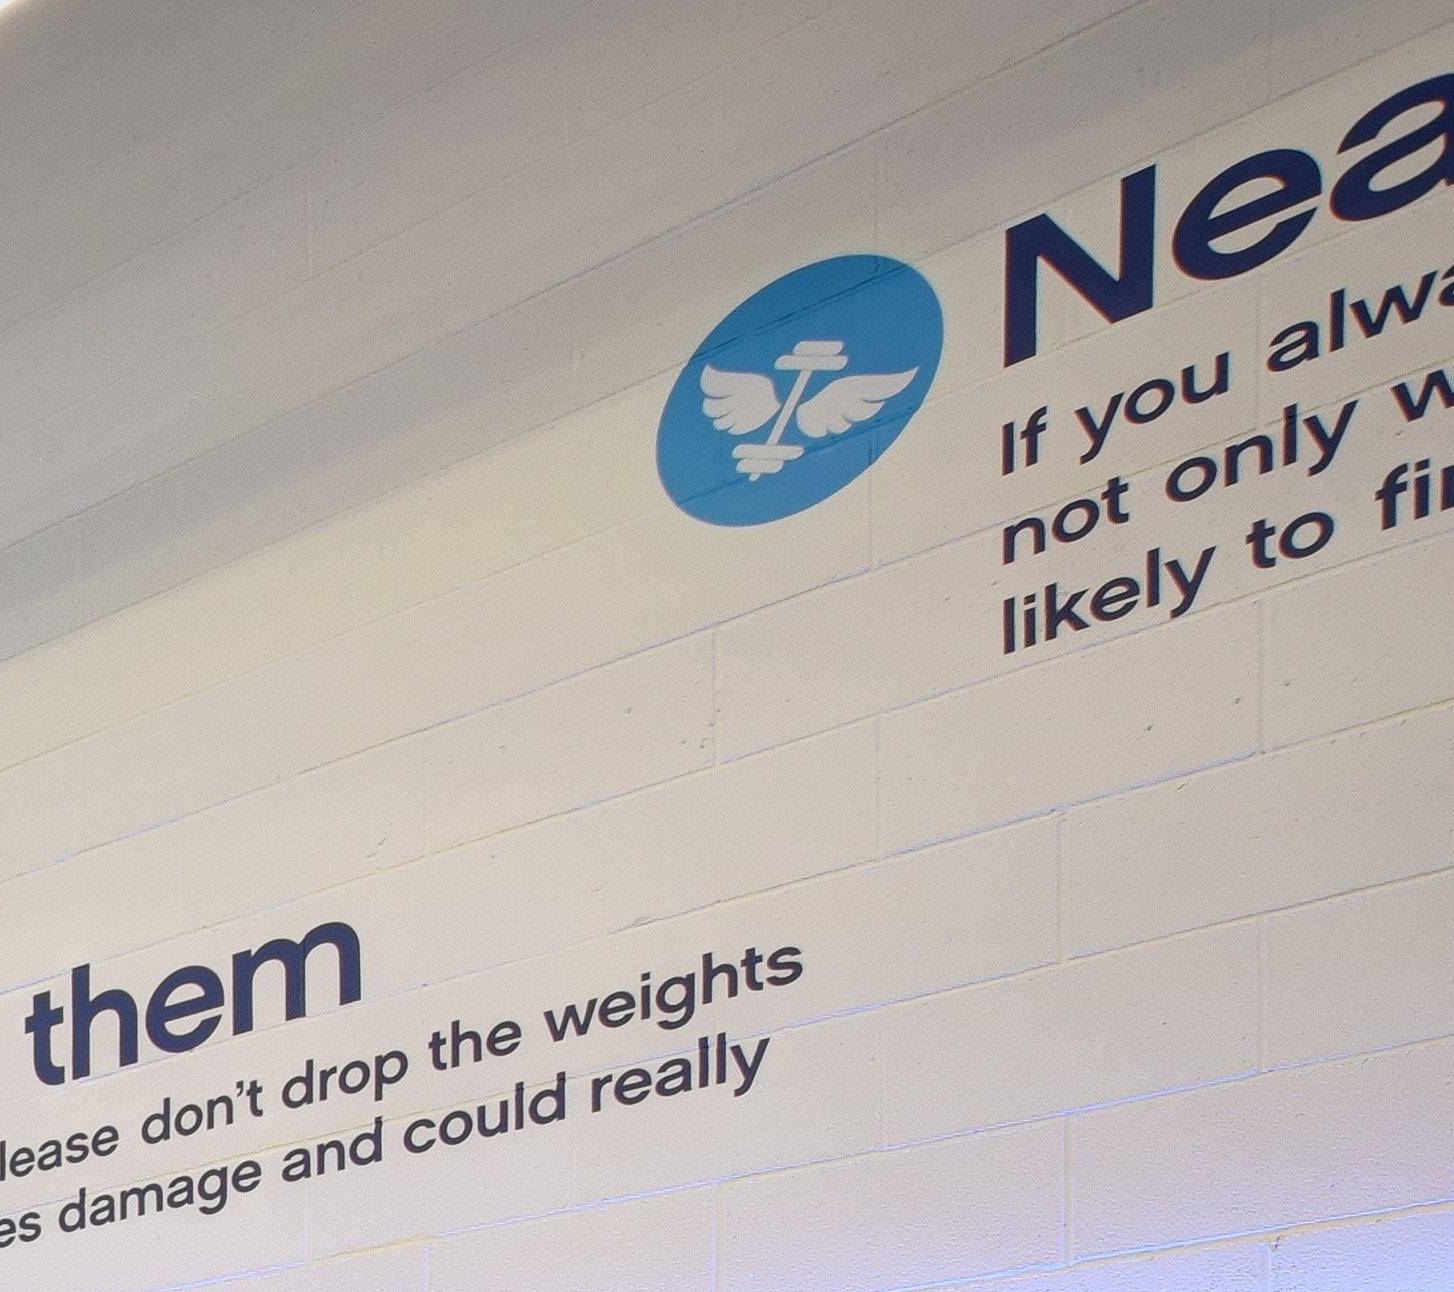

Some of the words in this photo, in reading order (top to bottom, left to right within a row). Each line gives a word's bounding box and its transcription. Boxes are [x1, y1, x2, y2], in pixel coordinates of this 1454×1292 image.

[1002, 405, 1048, 476] If
[1076, 351, 1230, 463] you
[1002, 476, 1130, 565] not
[1165, 399, 1358, 503] only
[1002, 546, 1216, 655] likely
[1245, 510, 1334, 569] to
[24, 921, 362, 1086] them
[141, 1079, 263, 1145] don't
[281, 1049, 409, 1108] drop
[428, 1019, 522, 1071] the
[543, 945, 804, 1043] weights
[58, 1157, 262, 1234] damage
[281, 1115, 383, 1183] and
[403, 1071, 566, 1155] could
[590, 1032, 770, 1114] really
